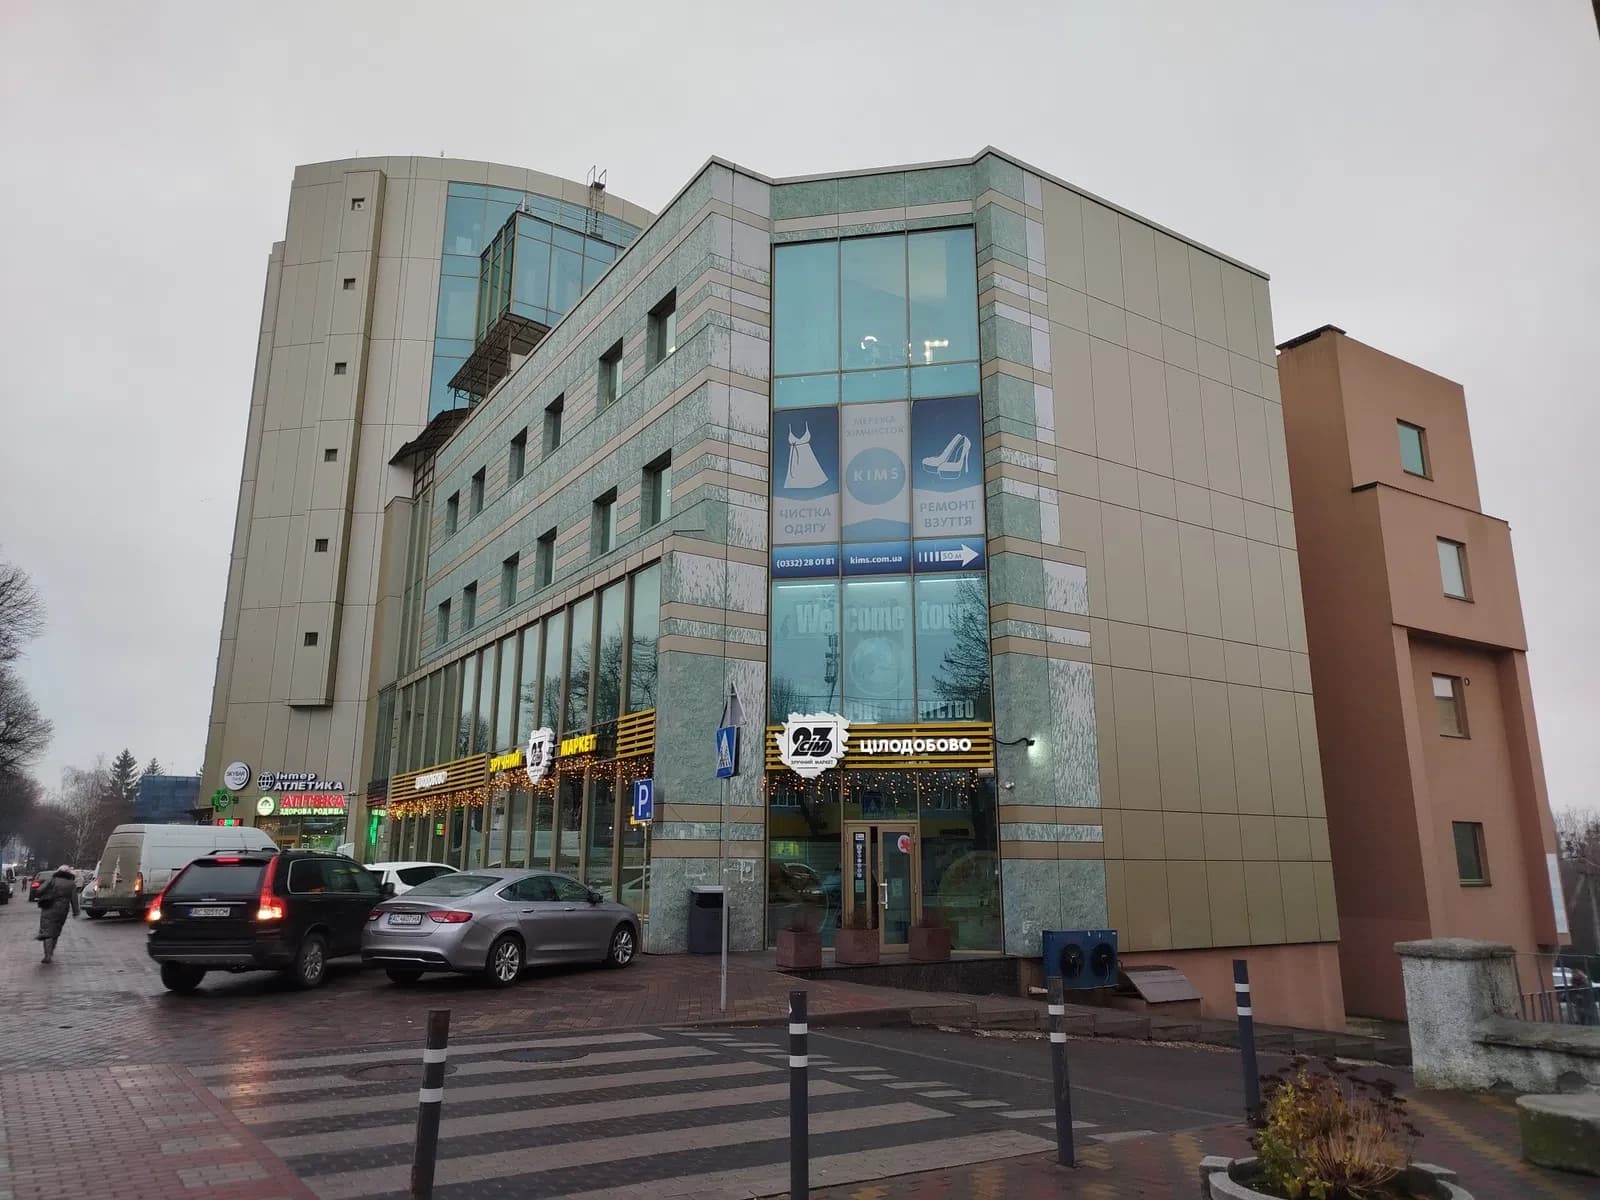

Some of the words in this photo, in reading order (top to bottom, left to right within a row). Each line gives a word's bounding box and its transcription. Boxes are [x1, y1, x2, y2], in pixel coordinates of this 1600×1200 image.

[853, 467, 900, 482] KIMS
[779, 506, 832, 520] ЧИСТКА
[919, 500, 976, 513] РЕМОНТ
[923, 515, 973, 529] ВЗУТТЯ
[784, 523, 827, 536] ОДЯГУ
[850, 555, 903, 565] kims.com.ua
[942, 552, 953, 560] 50
[776, 559, 803, 569] (0332)
[803, 559, 814, 567] 28
[814, 559, 825, 567] 01
[825, 558, 835, 566] 81
[561, 734, 597, 756] МАРКЕТ
[791, 726, 833, 757] 23
[860, 737, 972, 755] ЦІЛОДОБОВО
[489, 749, 522, 773] ЗРУЧНИЙ
[276, 771, 317, 781] Інтер
[274, 780, 344, 791] АТЛЕТИКА
[280, 793, 346, 808] АПТЕКА
[638, 784, 649, 817] P
[280, 807, 312, 816] ЗДОРОВА
[313, 807, 344, 816] РОДИНА
